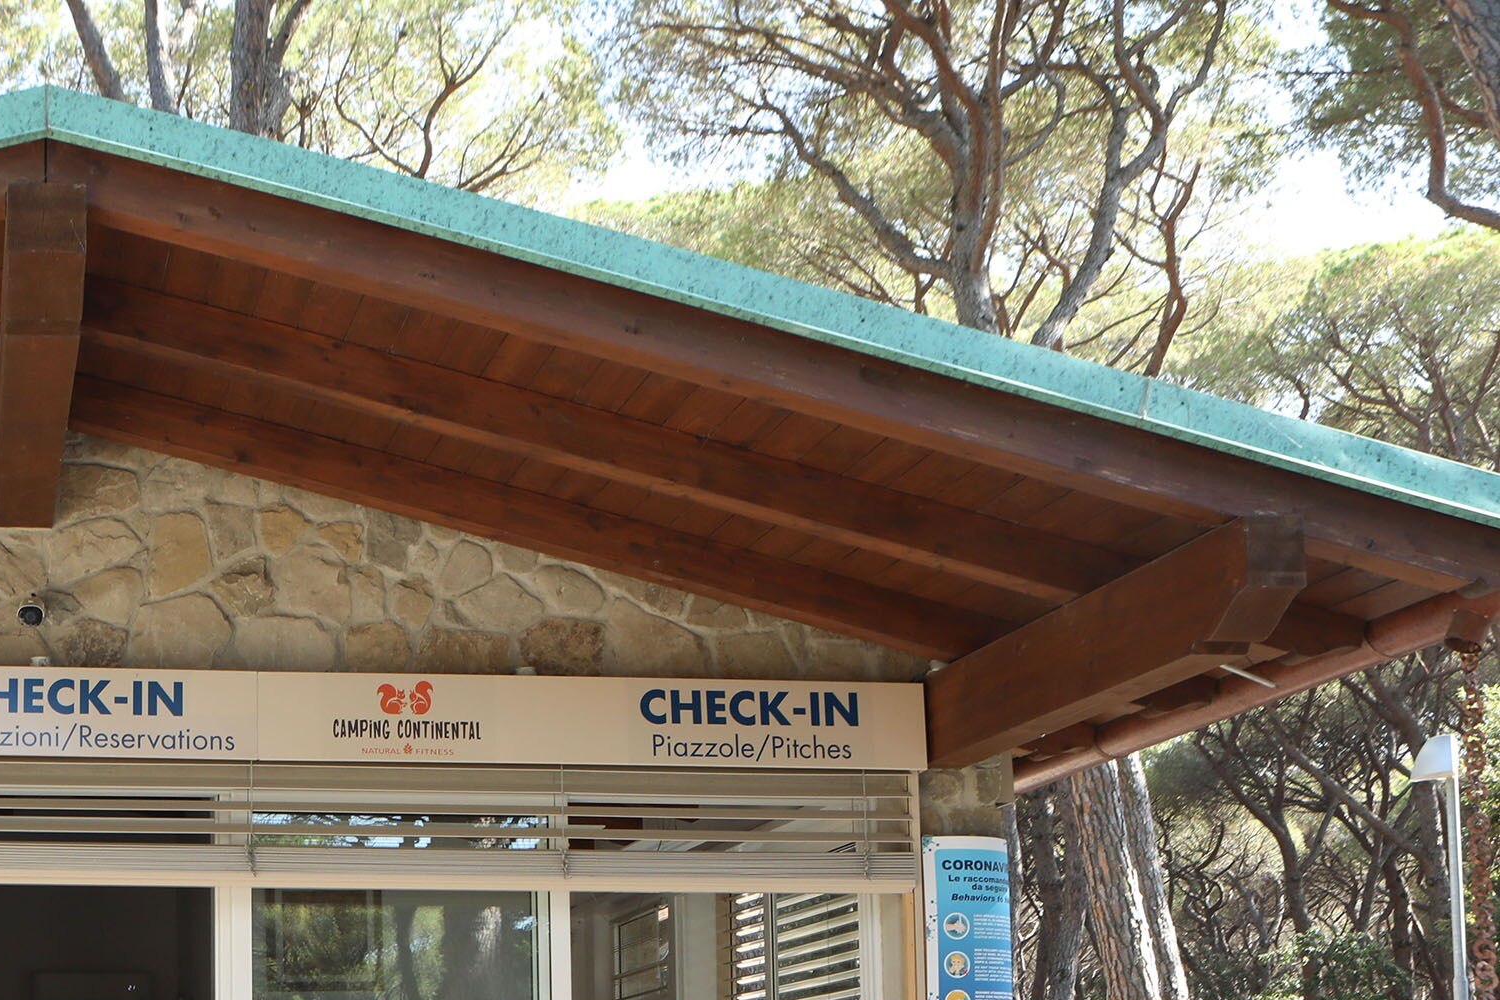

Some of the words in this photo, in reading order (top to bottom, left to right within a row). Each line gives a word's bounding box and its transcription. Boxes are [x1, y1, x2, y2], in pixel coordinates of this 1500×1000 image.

[639, 689, 859, 727] CHECK-IN
[361, 747, 401, 755] NATURAL
[415, 748, 454, 756] FITNESS
[652, 733, 852, 762] Piazzole/Pitches
[948, 874, 961, 882] Le
[972, 883, 983, 891] da
[951, 893, 996, 902] Behaviors
